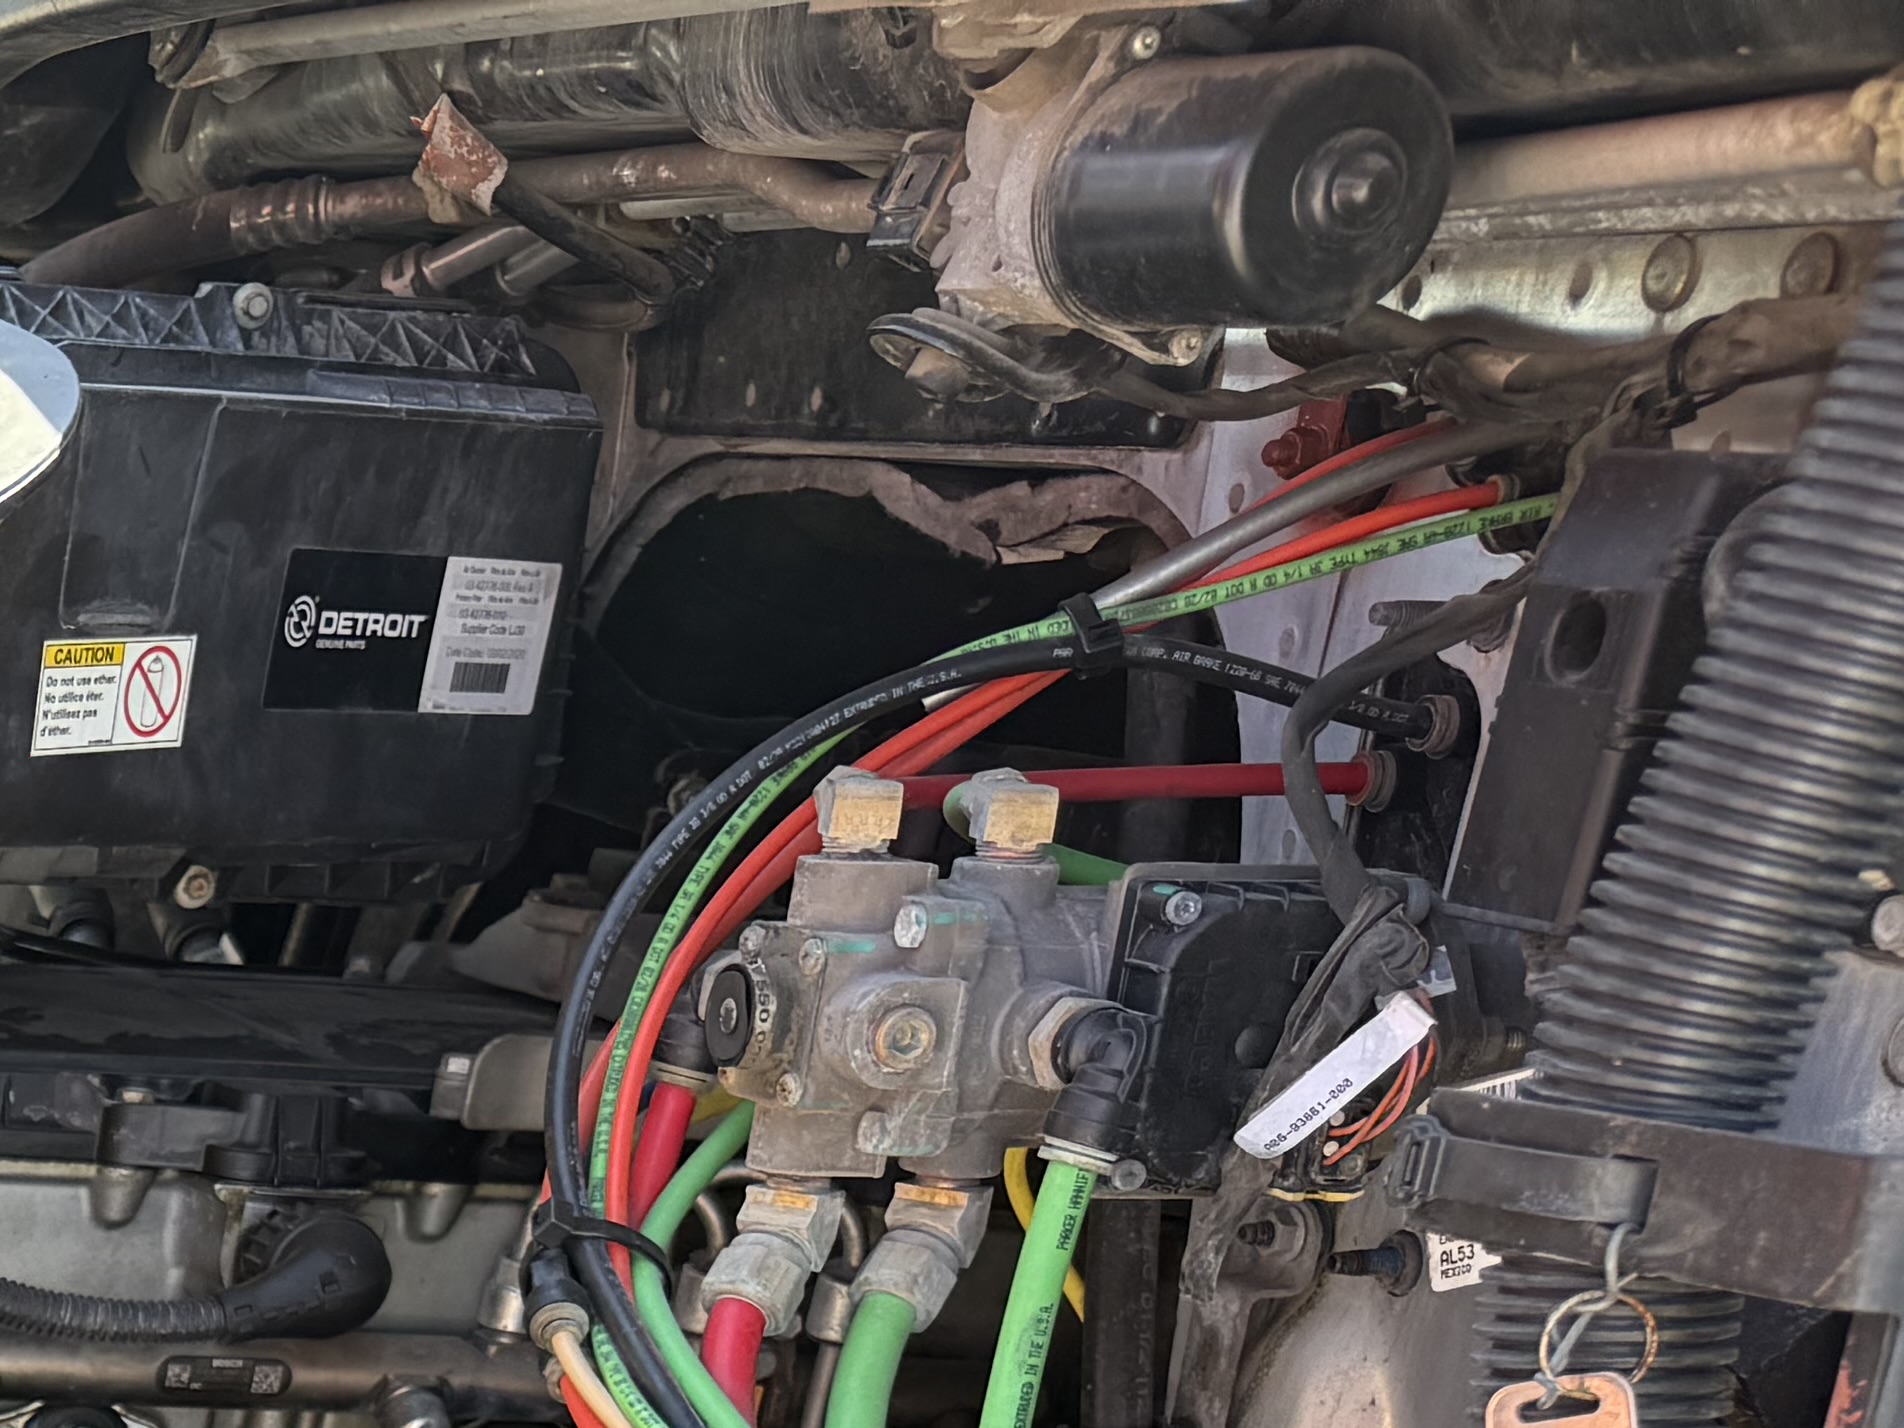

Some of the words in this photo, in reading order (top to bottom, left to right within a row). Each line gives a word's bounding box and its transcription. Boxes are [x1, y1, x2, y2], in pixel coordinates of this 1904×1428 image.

[318, 610, 431, 638] DETROIT
[54, 647, 114, 665] CAUTION
[45, 676, 58, 688] Do
[60, 676, 74, 687] not
[77, 675, 91, 686] use
[44, 693, 55, 704] No
[82, 708, 97, 721] pas
[1440, 1244, 1475, 1267] AL53
[1027, 1340, 1043, 1359] THE
[1024, 1364, 1038, 1376] IN
